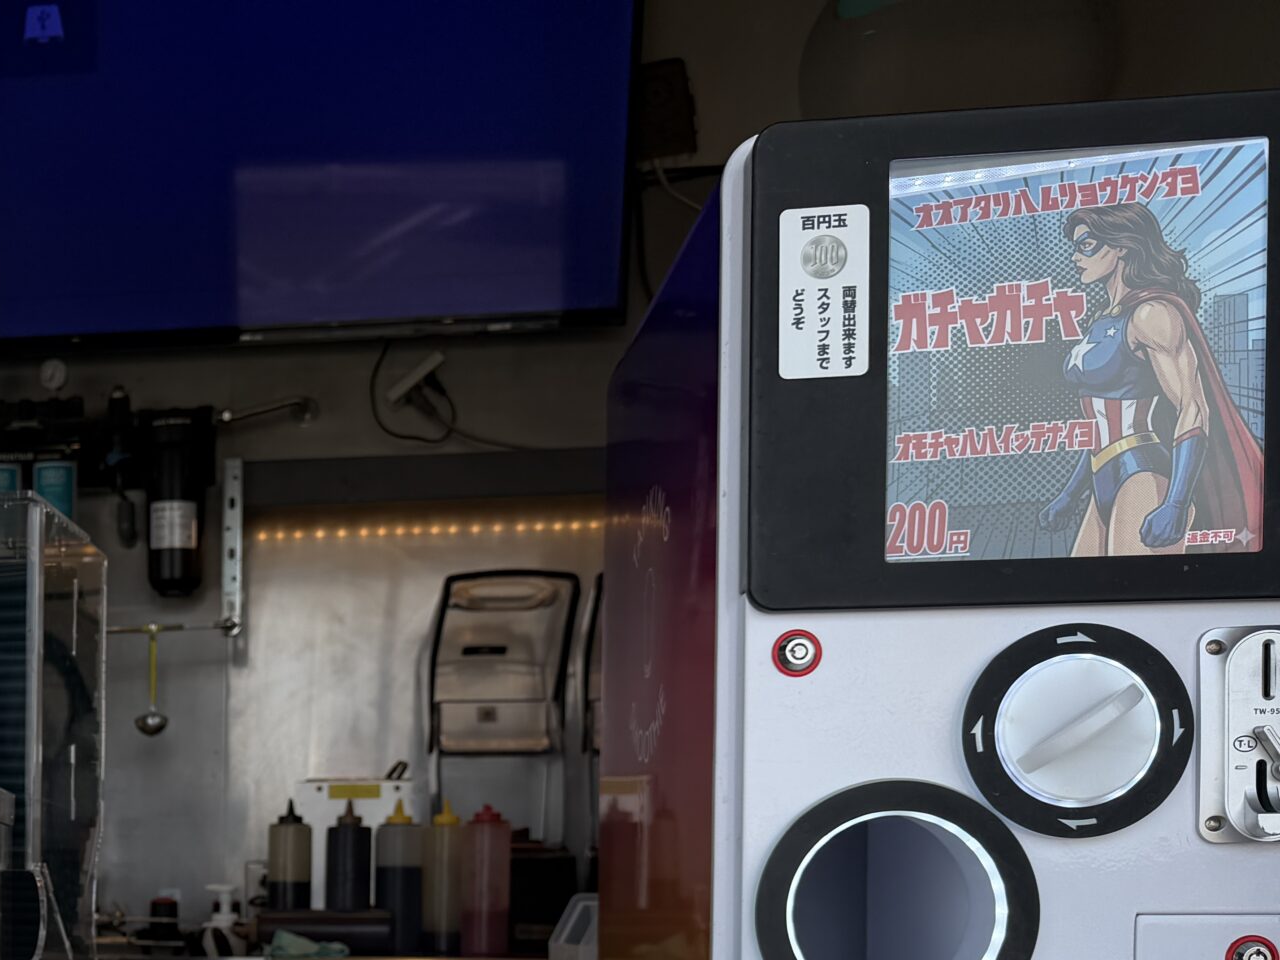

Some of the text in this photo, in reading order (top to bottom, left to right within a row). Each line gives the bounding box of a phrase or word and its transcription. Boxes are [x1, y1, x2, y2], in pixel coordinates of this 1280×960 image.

[801, 213, 848, 230] 百円玉
[792, 288, 805, 330] どうぞ
[817, 288, 830, 370] スタッフまで
[842, 285, 857, 369] 両替出来ます
[890, 277, 1087, 354] ガチャガチャ
[886, 500, 970, 556] 200円
[1186, 528, 1235, 544] 返金不可
